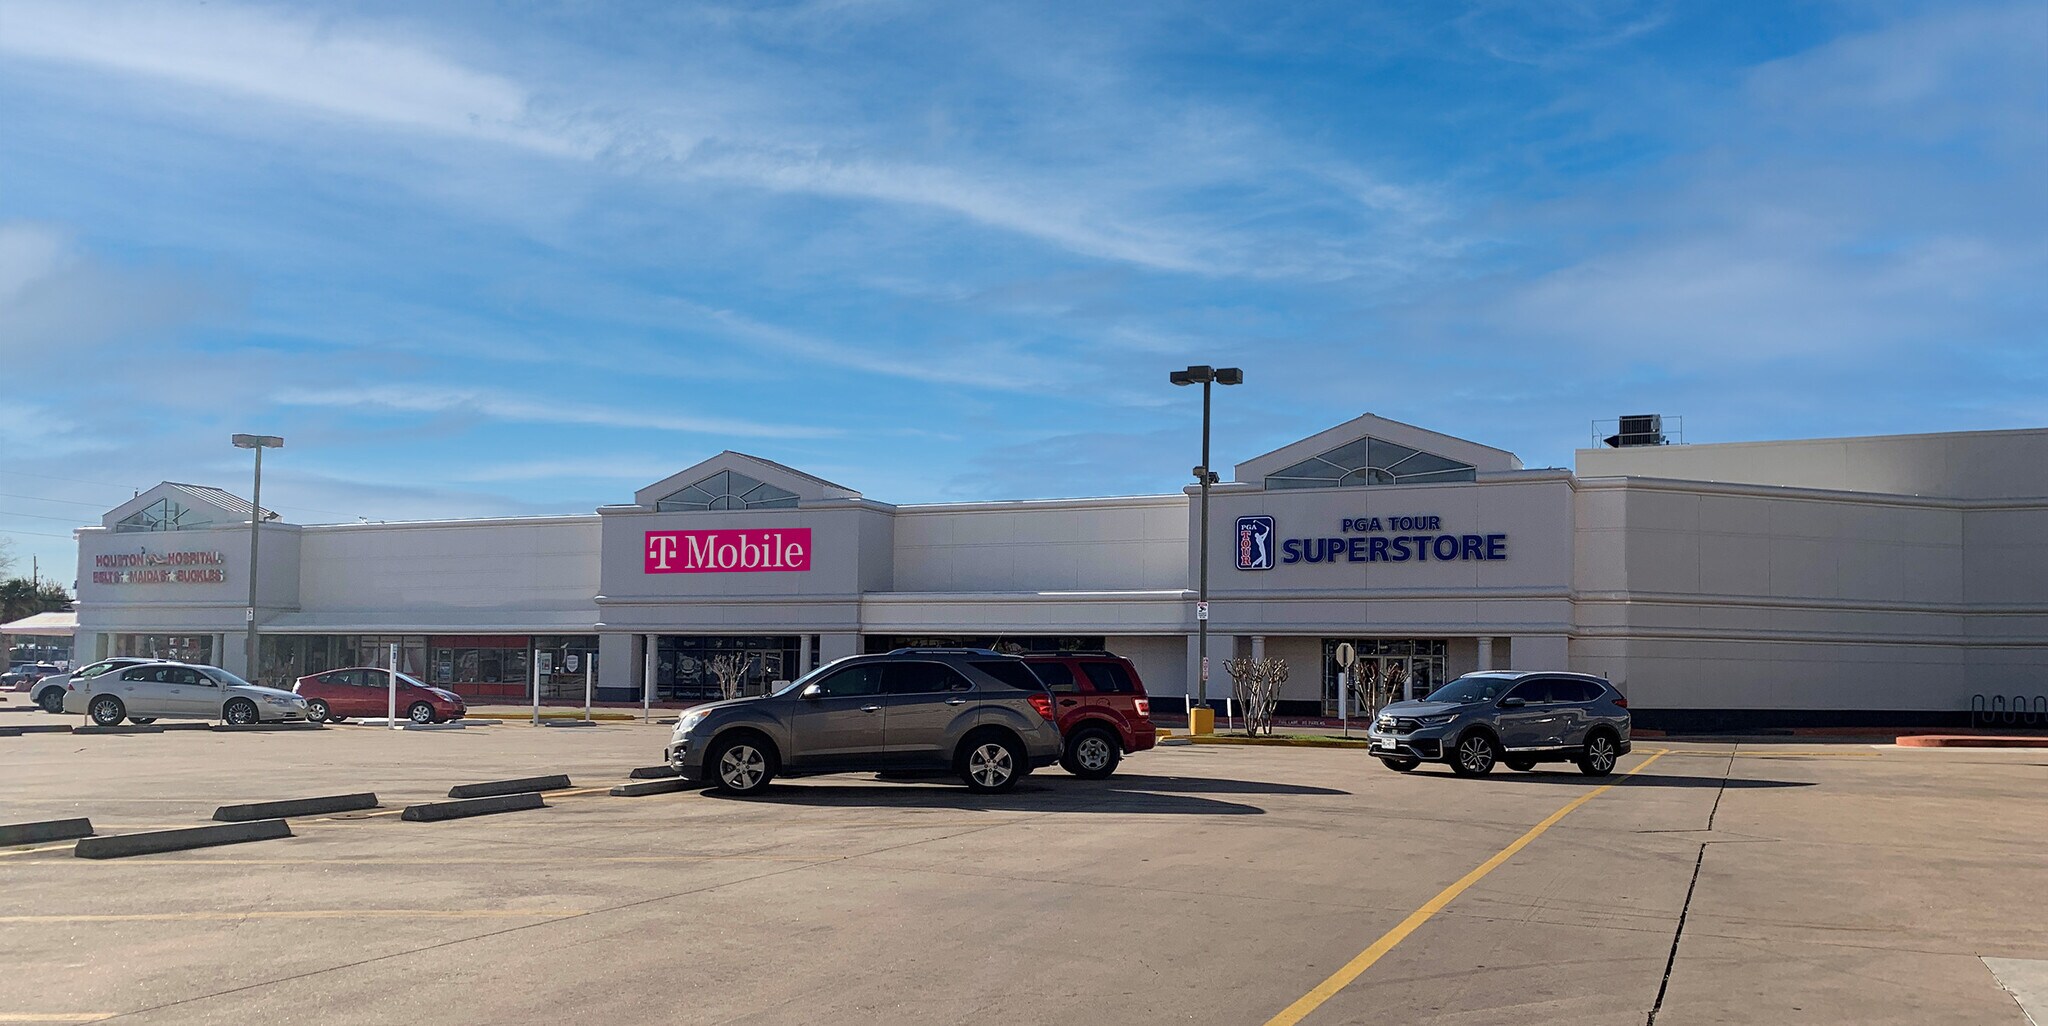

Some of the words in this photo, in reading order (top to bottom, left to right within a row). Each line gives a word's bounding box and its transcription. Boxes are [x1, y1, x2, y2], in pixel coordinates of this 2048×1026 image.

[1342, 518, 1383, 532] PGA
[1388, 516, 1440, 531] TOUR
[96, 553, 146, 567] HOUSTON
[168, 551, 222, 565] HOSPITAL
[684, 534, 804, 569] Mobile
[1240, 531, 1251, 566] TOUR
[1283, 534, 1507, 563] SUPERSTORE
[93, 571, 120, 583] BELTS
[177, 569, 224, 582] BUCKLES
